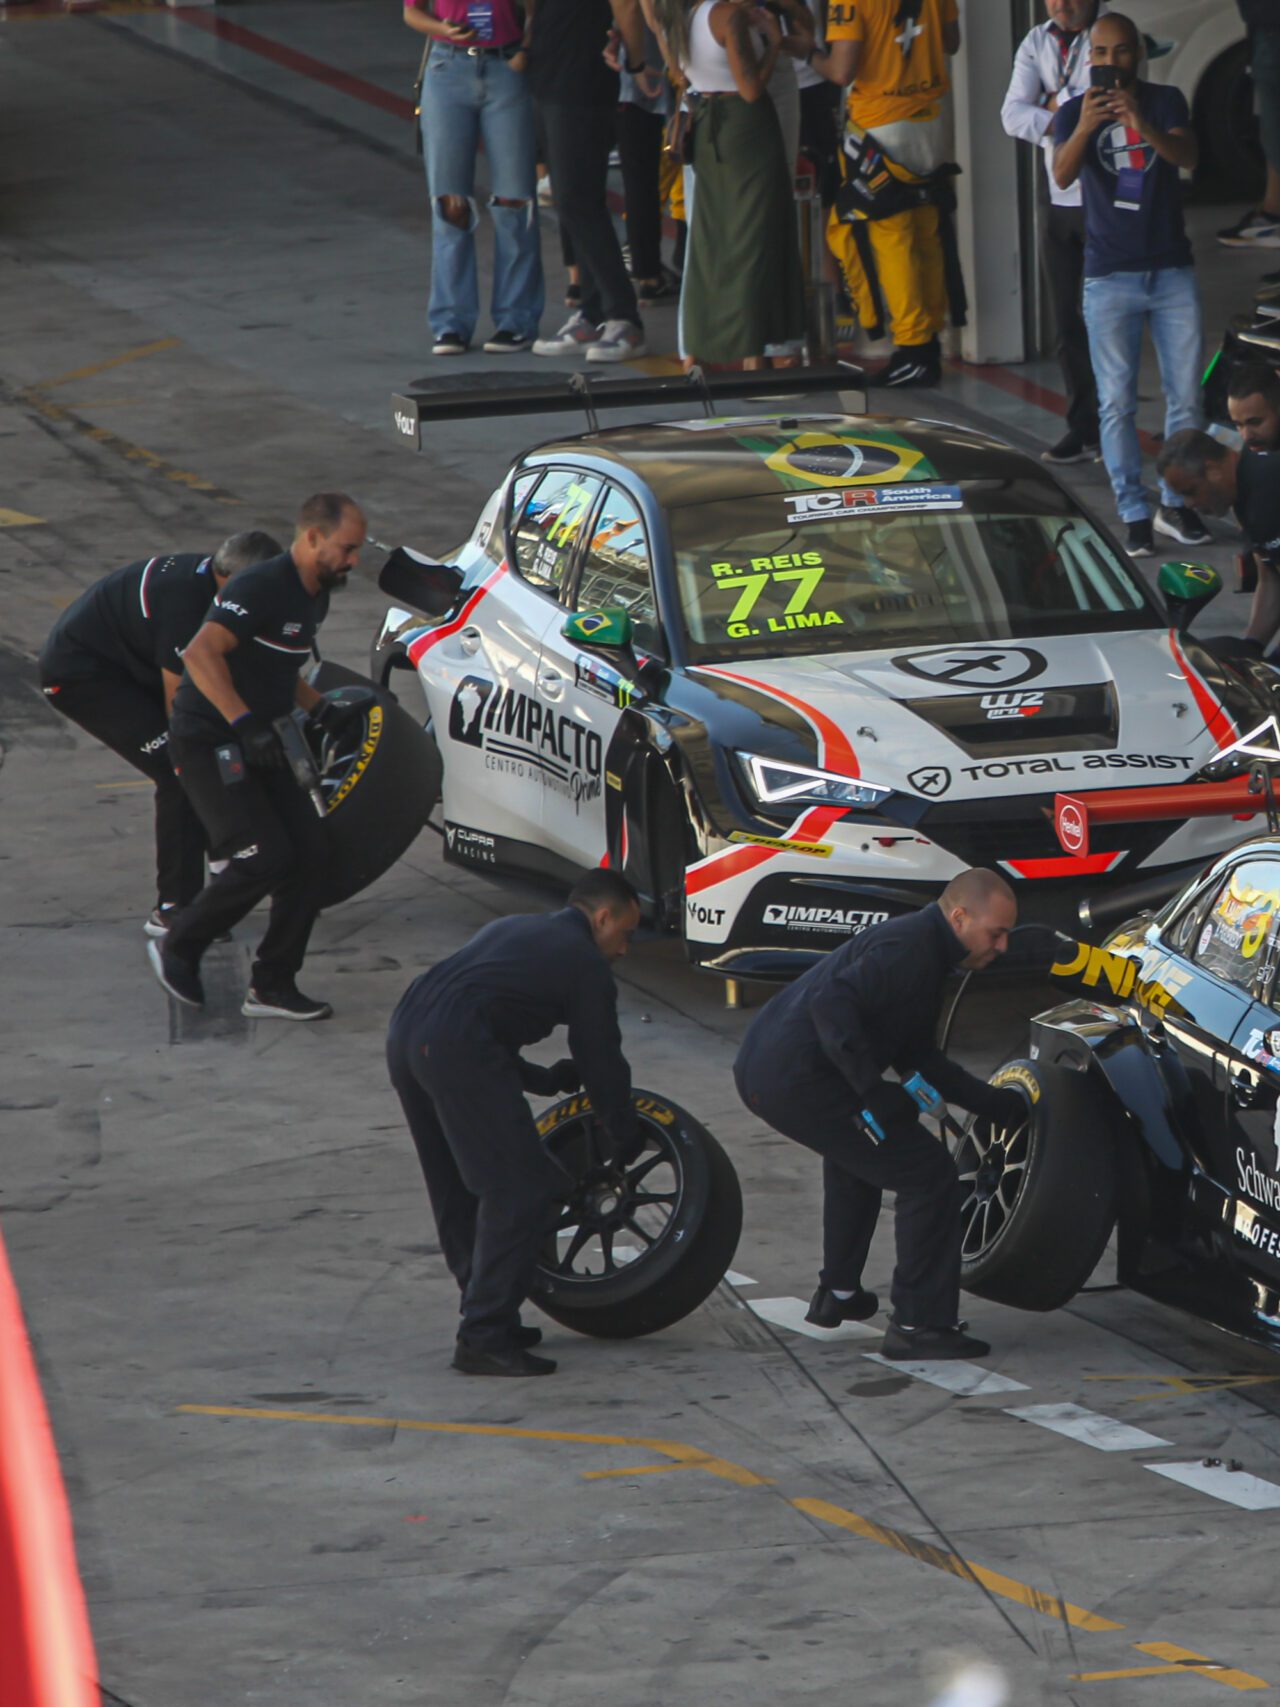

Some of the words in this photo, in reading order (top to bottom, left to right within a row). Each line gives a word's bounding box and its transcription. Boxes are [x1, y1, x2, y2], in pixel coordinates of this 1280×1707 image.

[784, 488, 879, 513] TCR
[881, 487, 931, 496] South
[881, 492, 952, 503] America
[711, 562, 743, 577] R.
[750, 552, 823, 572] REIS
[716, 567, 825, 623] 77
[727, 622, 760, 638] G.
[767, 610, 844, 632] LIMA
[484, 683, 602, 777] IMPACTO
[140, 731, 169, 753] VOLT
[485, 754, 524, 777] CENTRO
[1061, 817, 1082, 838] Henkel
[457, 843, 496, 863] RACING
[751, 836, 828, 855] DUNLOP
[687, 902, 726, 926] VOLT
[787, 906, 889, 926] IMPACTO
